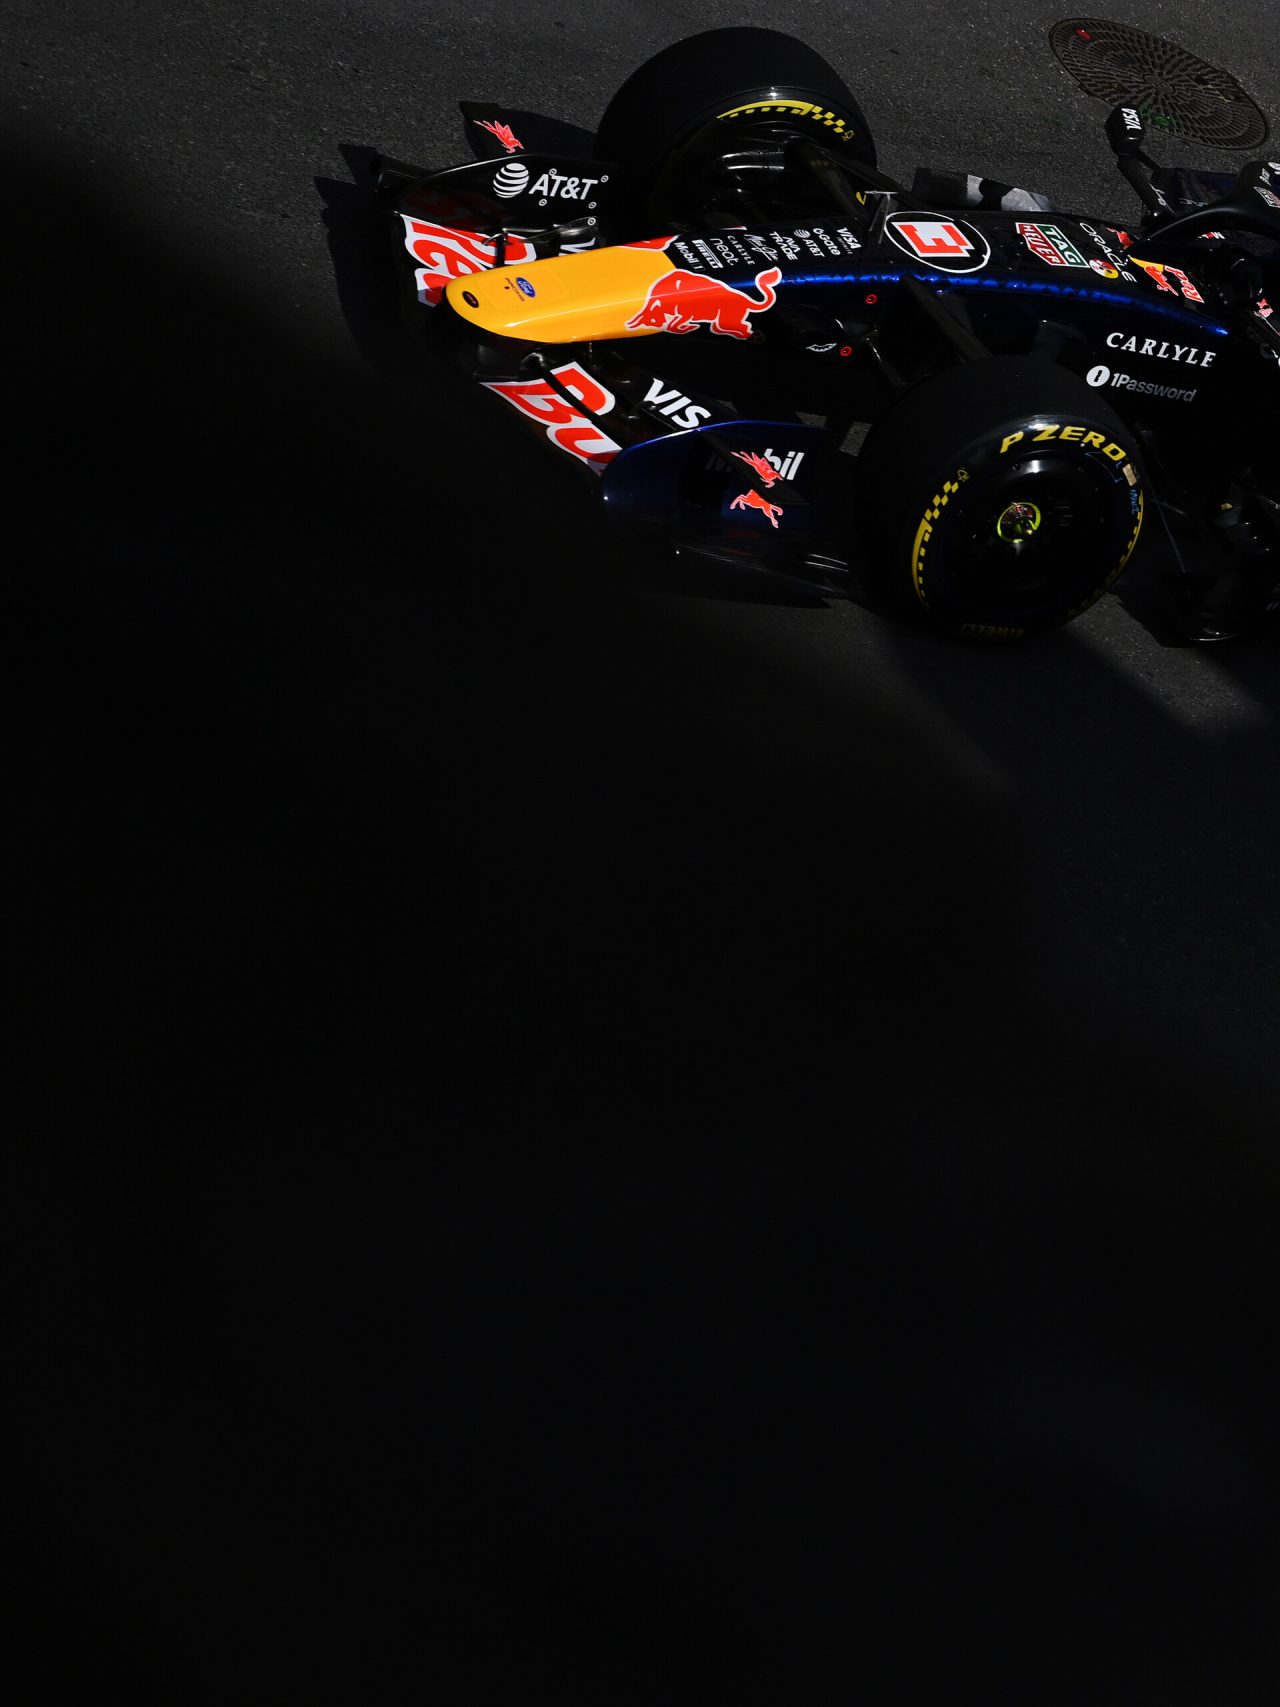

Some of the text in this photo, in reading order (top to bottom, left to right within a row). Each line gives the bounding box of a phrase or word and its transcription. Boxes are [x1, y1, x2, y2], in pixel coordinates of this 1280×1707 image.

[529, 174, 599, 200] AT&T
[727, 235, 756, 265] CARLYLE
[837, 227, 862, 250] VISA
[1018, 224, 1061, 266] HEUER
[1045, 225, 1084, 266] TAG
[1079, 223, 1138, 283] ORACLE
[400, 213, 537, 307] Re
[1105, 332, 1217, 368] CARLYLE
[642, 377, 712, 431] VIS
[1111, 372, 1198, 402] 1Password
[1000, 424, 1128, 462] P ZERO
